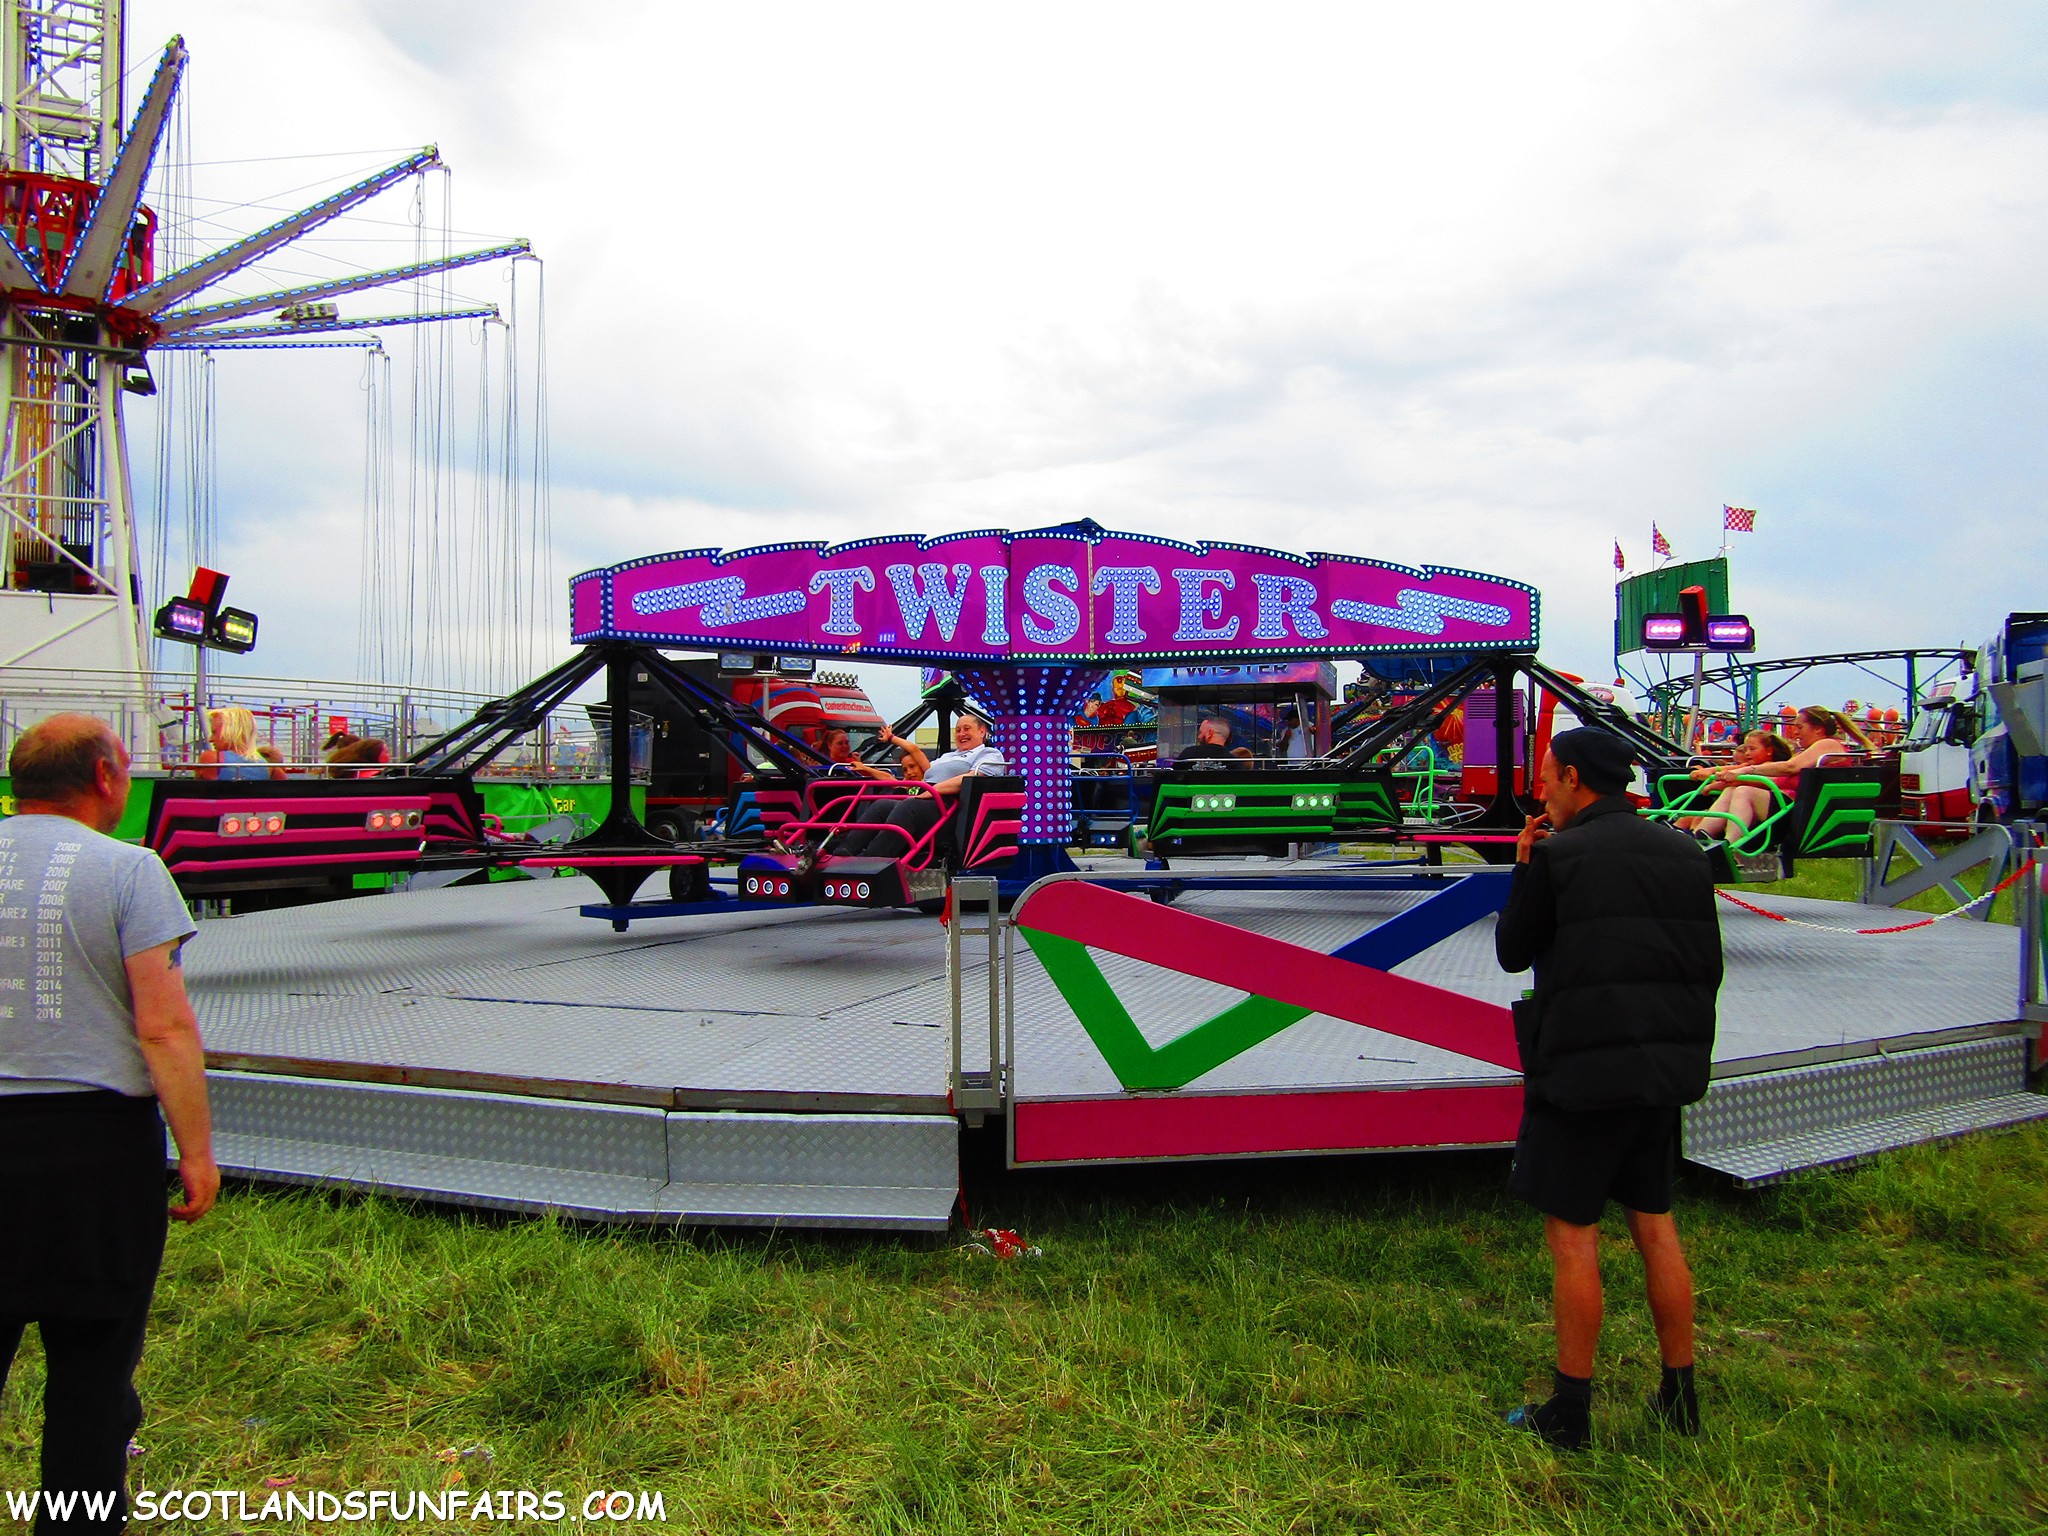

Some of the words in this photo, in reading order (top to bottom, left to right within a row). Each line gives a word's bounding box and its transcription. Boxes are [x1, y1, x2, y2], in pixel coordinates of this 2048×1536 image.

[808, 562, 1330, 645] TWISTER
[49, 854, 77, 864] 2005
[45, 866, 71, 878] 2006
[41, 880, 68, 892] 2007
[38, 894, 65, 906] 2008
[20, 907, 28, 919] 2
[37, 908, 63, 920] 2009
[36, 923, 63, 935] 2010
[19, 936, 26, 948] 3
[36, 937, 61, 948] 2011
[36, 951, 63, 963] 2012
[36, 965, 63, 977] 2013
[35, 979, 62, 991] 2014
[35, 993, 63, 1005] 2015
[35, 1007, 62, 1019] 2016
